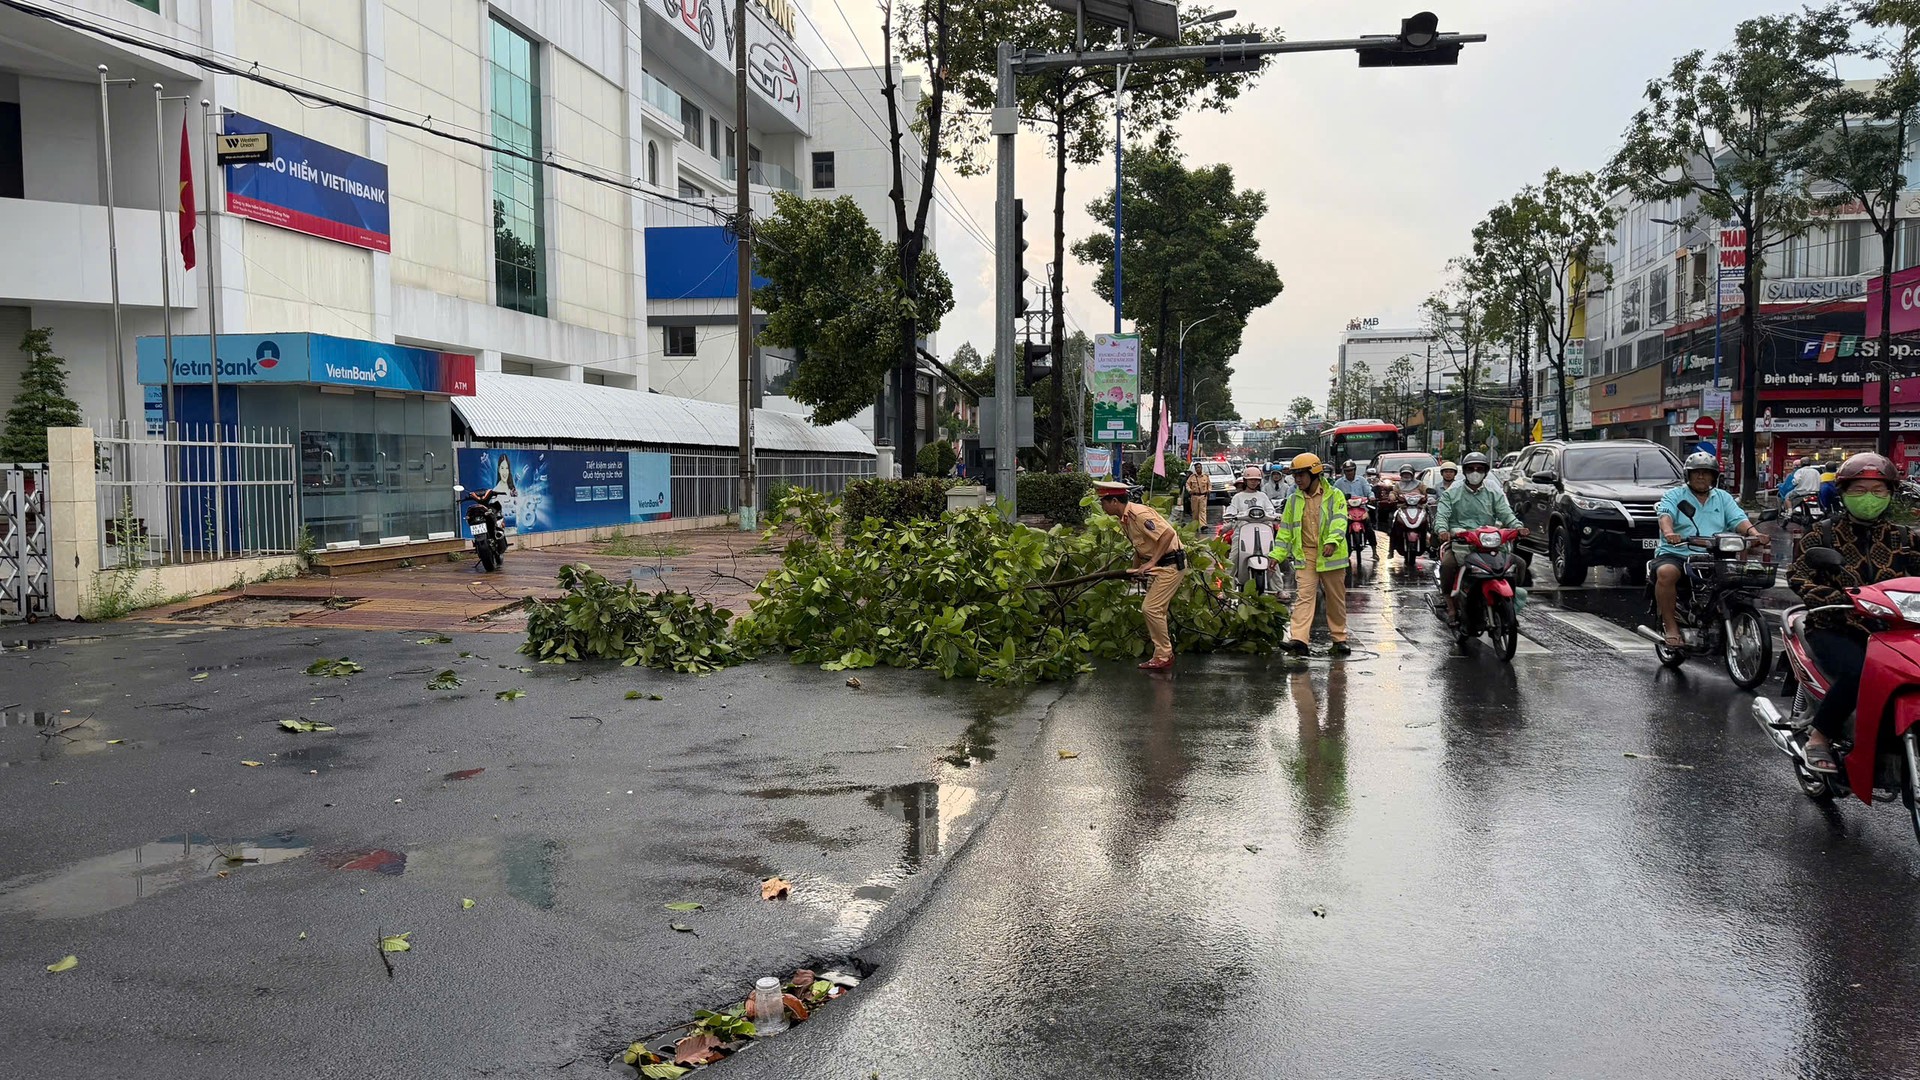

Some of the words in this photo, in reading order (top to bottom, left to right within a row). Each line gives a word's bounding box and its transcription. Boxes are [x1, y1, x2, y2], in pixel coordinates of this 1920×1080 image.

[289, 160, 318, 184] HIỂM
[321, 170, 386, 204] VIETINBANK
[1720, 230, 1746, 247] THAN
[1720, 250, 1746, 268] PHON
[1768, 281, 1862, 299] SAMSUNG
[1363, 318, 1379, 326] MB
[164, 358, 258, 376] VietinBank
[326, 363, 376, 381] VietinBank
[1764, 373, 1786, 386] Điện
[1788, 373, 1812, 386] thoại
[1818, 372, 1838, 385] Máy
[1841, 372, 1860, 382] tính
[454, 381, 467, 391] ATM
[1812, 406, 1828, 414] TÂM
[586, 461, 595, 469] Tiết
[596, 461, 606, 471] kiệm
[582, 470, 593, 479] Quà
[594, 471, 605, 480] tặng
[638, 500, 659, 508] VietinBank
[1643, 540, 1658, 548] 66A
